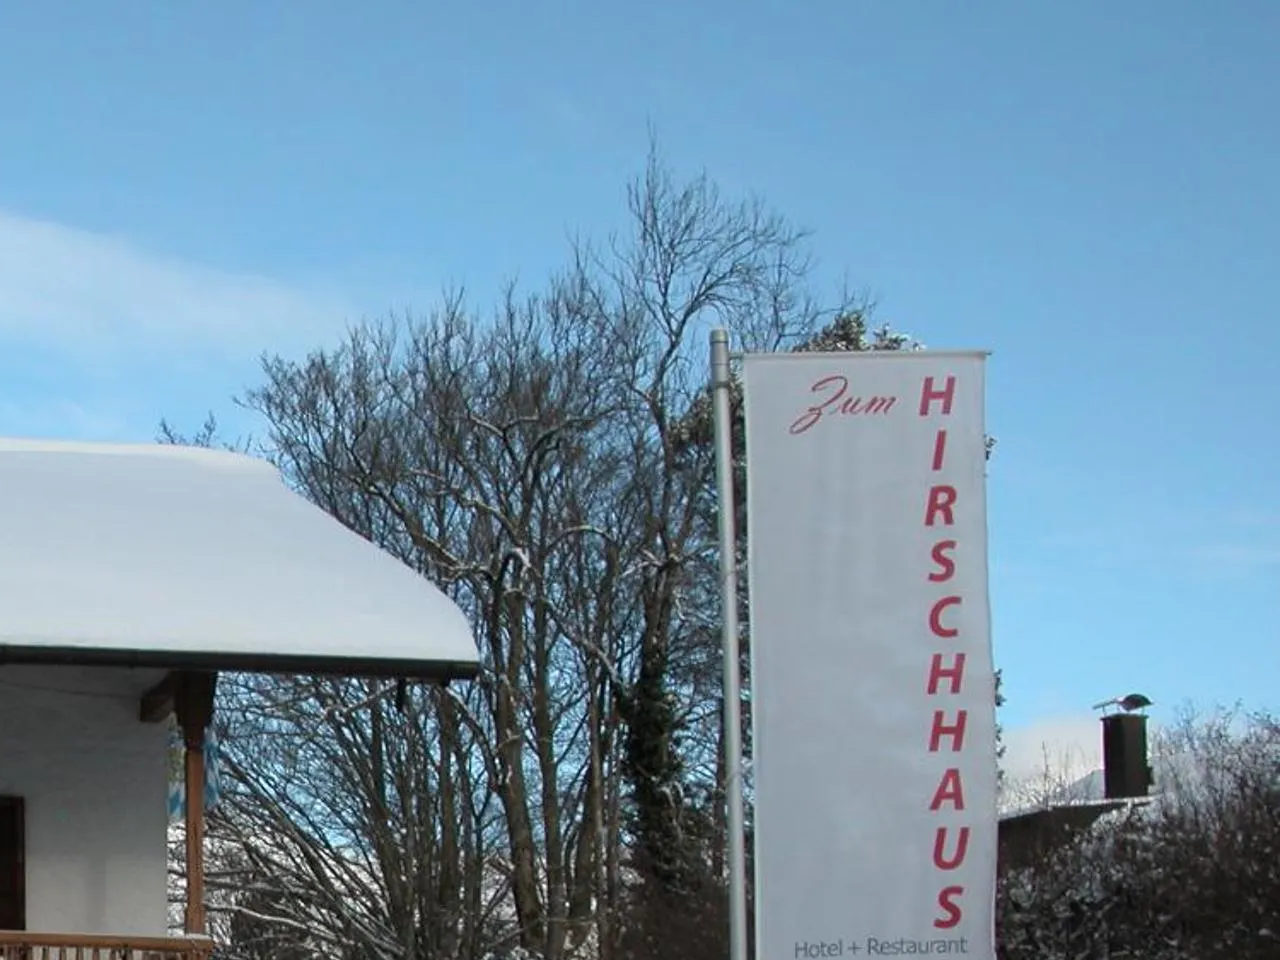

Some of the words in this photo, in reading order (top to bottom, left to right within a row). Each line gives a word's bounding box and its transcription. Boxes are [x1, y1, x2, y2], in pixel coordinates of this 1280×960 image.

[789, 375, 899, 435] Zum
[919, 376, 969, 929] HIRSCHHAUS
[794, 939, 843, 959] Hotel
[867, 936, 968, 956] Restaurant
